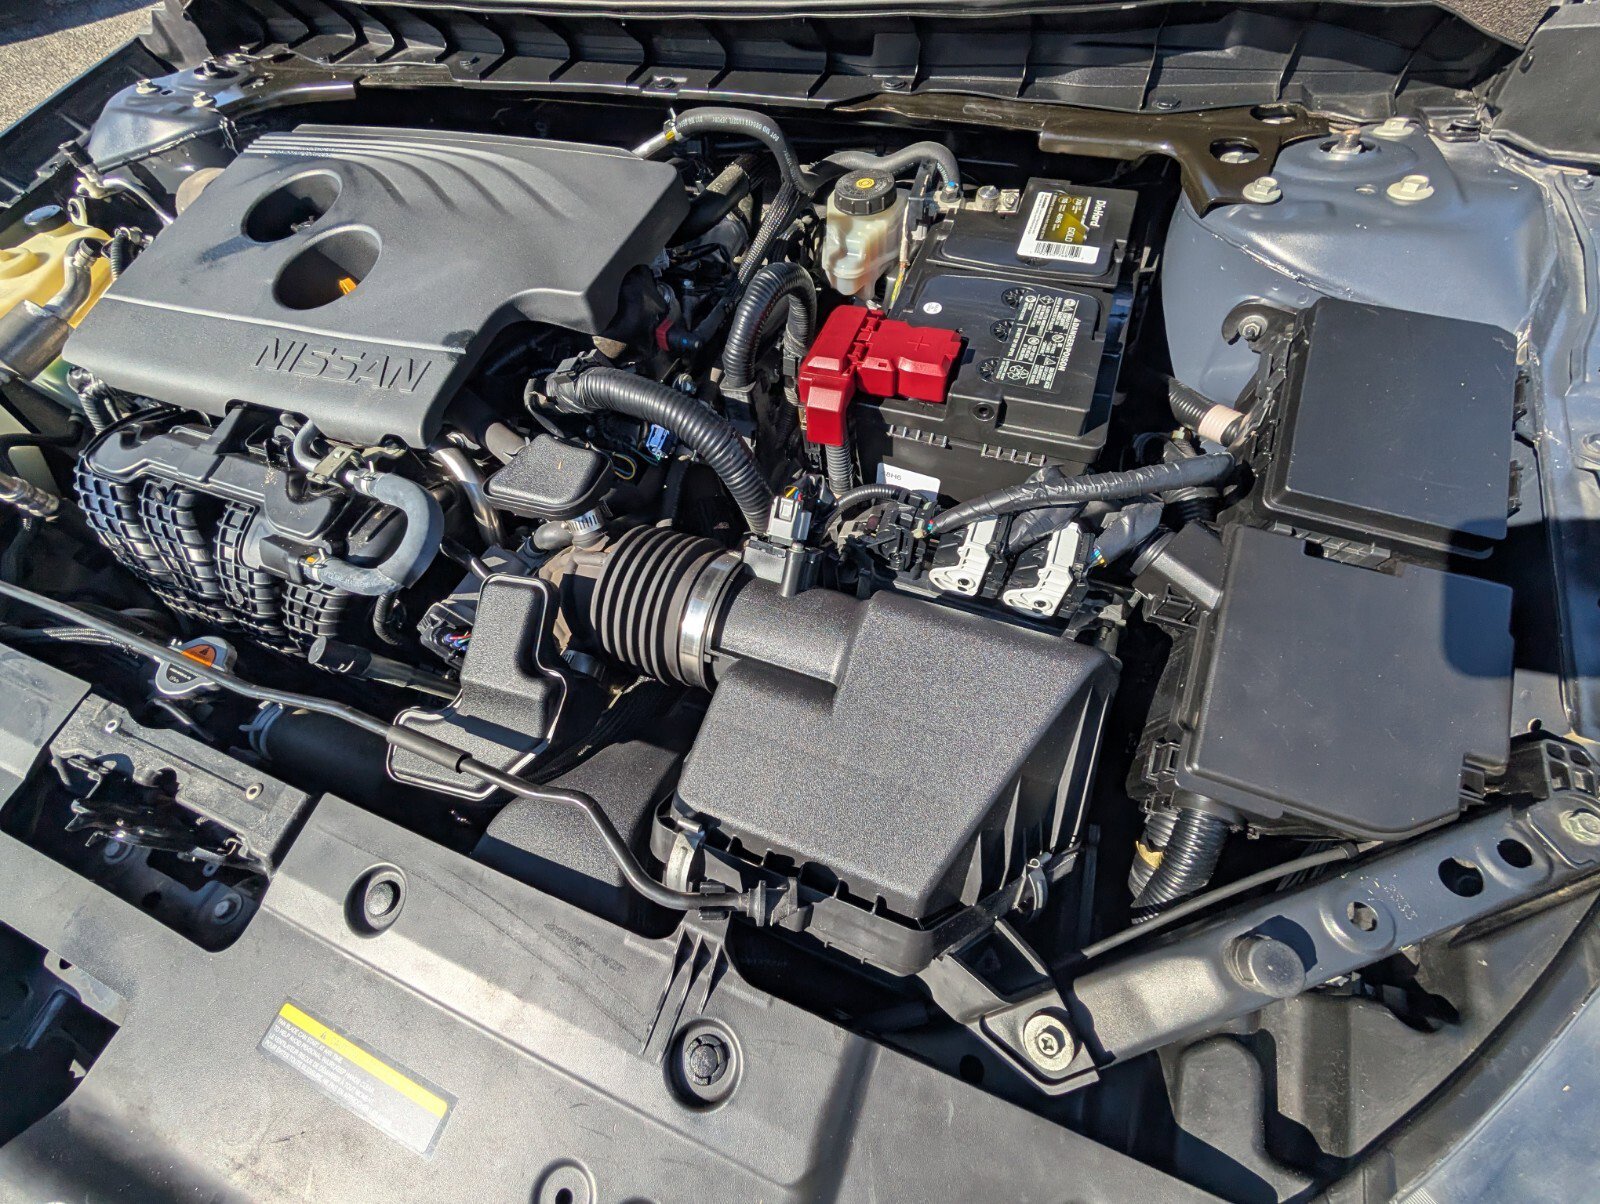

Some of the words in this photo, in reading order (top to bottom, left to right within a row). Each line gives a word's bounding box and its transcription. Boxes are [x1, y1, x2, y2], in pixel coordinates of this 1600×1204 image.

[1090, 199, 1107, 228] DieHard
[1064, 226, 1076, 242] GOLD
[254, 336, 434, 394] NISSAN
